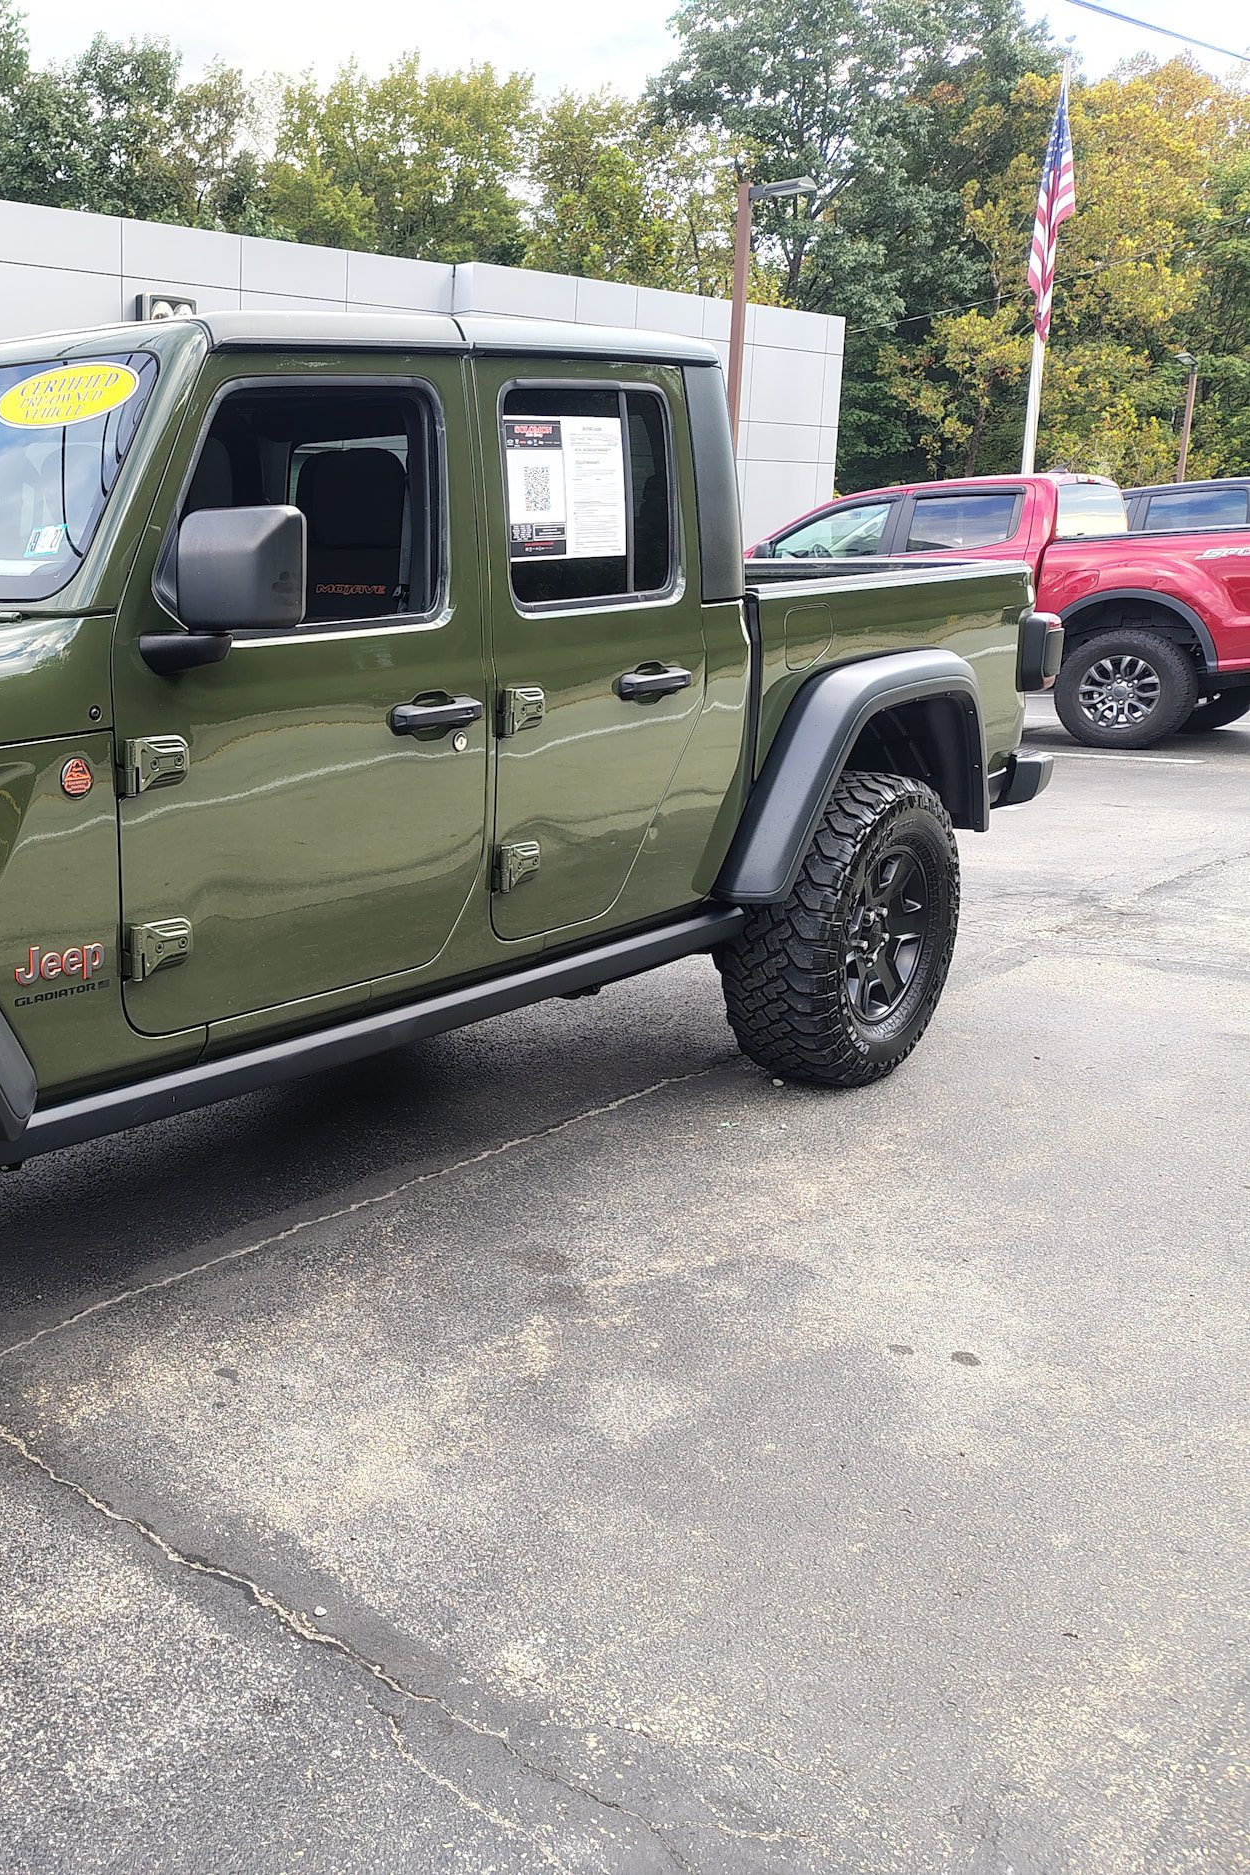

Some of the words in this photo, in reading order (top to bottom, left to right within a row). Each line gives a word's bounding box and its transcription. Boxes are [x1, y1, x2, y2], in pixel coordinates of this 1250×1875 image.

[20, 372, 120, 397] CERTIFIED
[20, 390, 103, 409] PRE-OWNED
[24, 404, 86, 420] VEHICLE
[316, 584, 386, 595] MOJAVE
[15, 942, 105, 988] Jeep
[14, 982, 96, 1008] GLADIATOR
